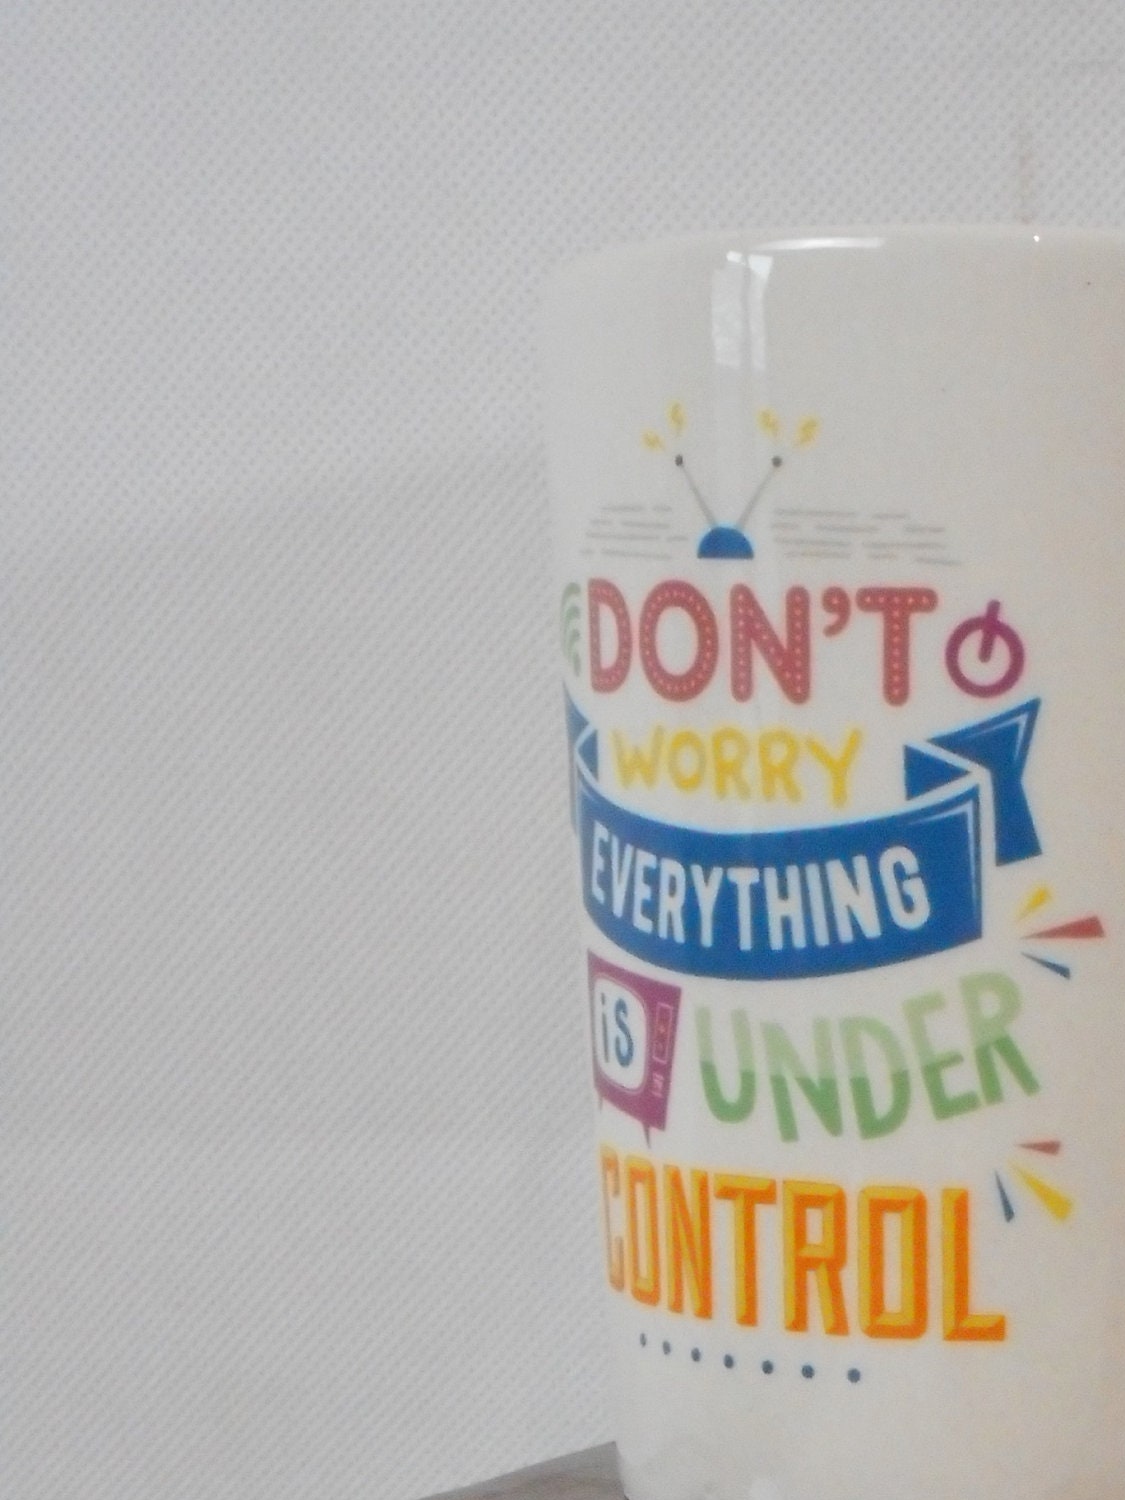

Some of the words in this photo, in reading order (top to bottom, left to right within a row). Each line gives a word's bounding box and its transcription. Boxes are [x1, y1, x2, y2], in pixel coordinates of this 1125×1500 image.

[587, 577, 939, 707] DON'T
[611, 725, 864, 808] WORRY
[590, 820, 931, 952] EVERYTHING
[695, 971, 1041, 1144] UNDER
[600, 1146, 1007, 1343] CONTROL
